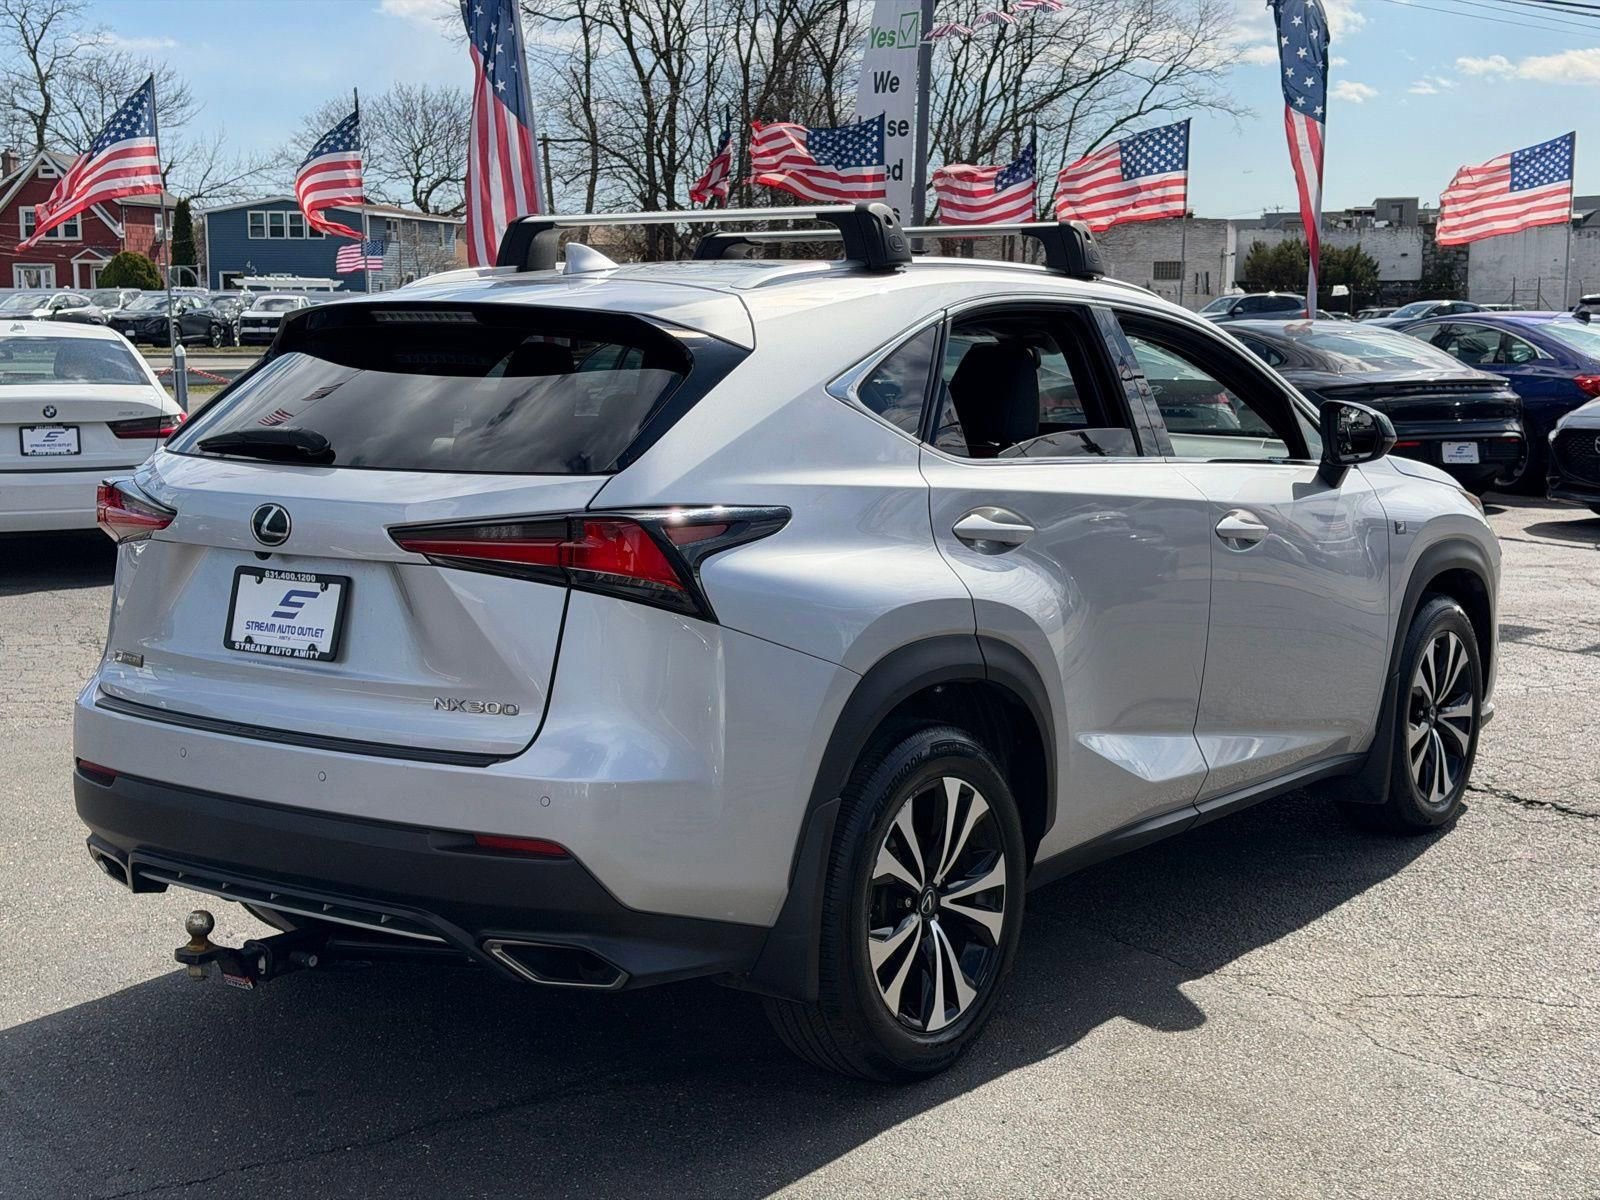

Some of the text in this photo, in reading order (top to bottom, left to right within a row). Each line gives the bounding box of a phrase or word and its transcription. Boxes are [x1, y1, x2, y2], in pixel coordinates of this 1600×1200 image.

[869, 26, 897, 49] Yes
[873, 70, 900, 94] We
[264, 570, 316, 582] 631.400.1200
[245, 620, 325, 639] STREAM AUTO OUTLET
[234, 642, 320, 659] STREAM AUTO AMITY
[433, 696, 520, 716] NX300
